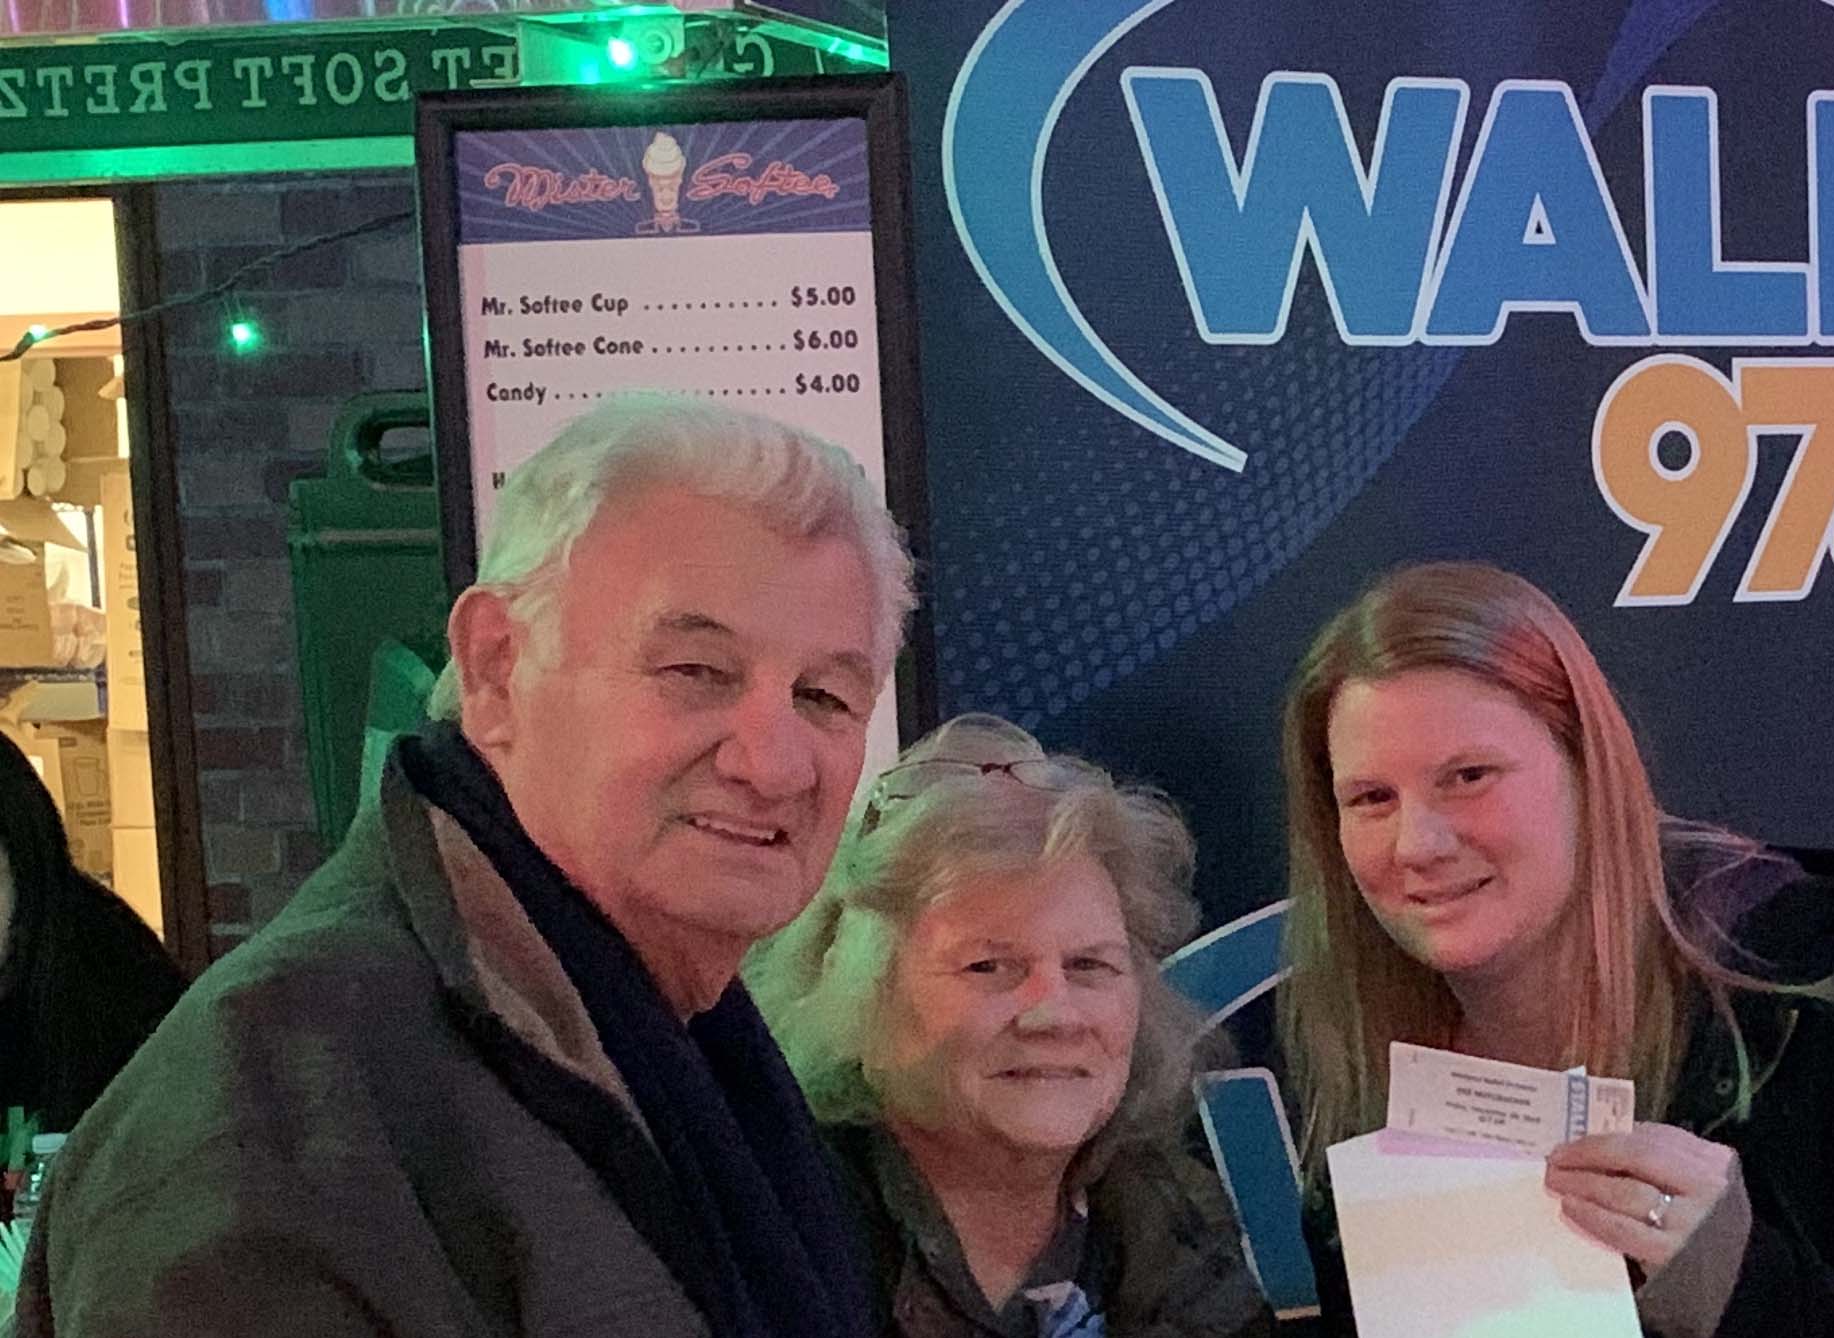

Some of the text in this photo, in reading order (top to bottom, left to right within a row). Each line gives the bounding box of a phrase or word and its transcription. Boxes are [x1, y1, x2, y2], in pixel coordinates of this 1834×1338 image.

[484, 152, 840, 210] Mister Softee
[481, 286, 855, 317] Mr. Softee Cup $5.00
[484, 329, 858, 358] Mr. Softee Cone $6.00
[486, 372, 860, 405] Candy $4.00
